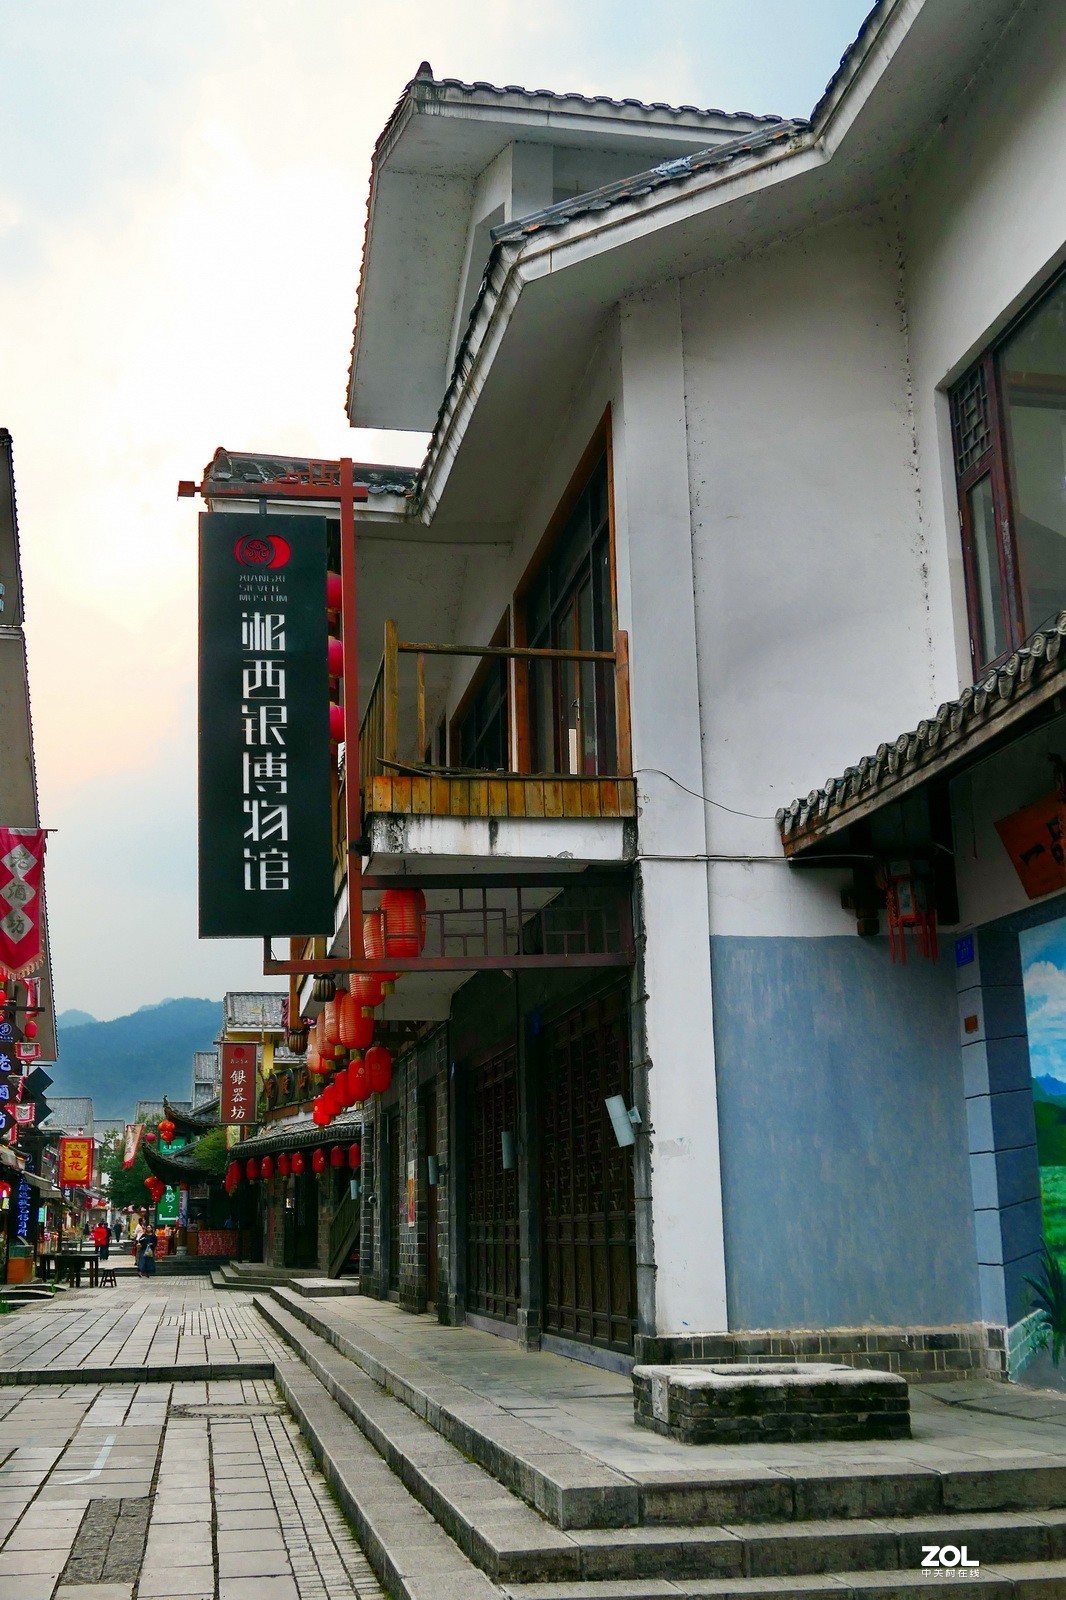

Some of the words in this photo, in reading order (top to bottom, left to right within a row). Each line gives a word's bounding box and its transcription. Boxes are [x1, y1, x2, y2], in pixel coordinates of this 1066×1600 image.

[239, 574, 286, 583] XIANGXI
[239, 594, 288, 602] MUSEUM
[241, 611, 289, 891] 湘西银博物馆
[7, 850, 28, 935] 老酒坊
[68, 1149, 84, 1171] 豆花
